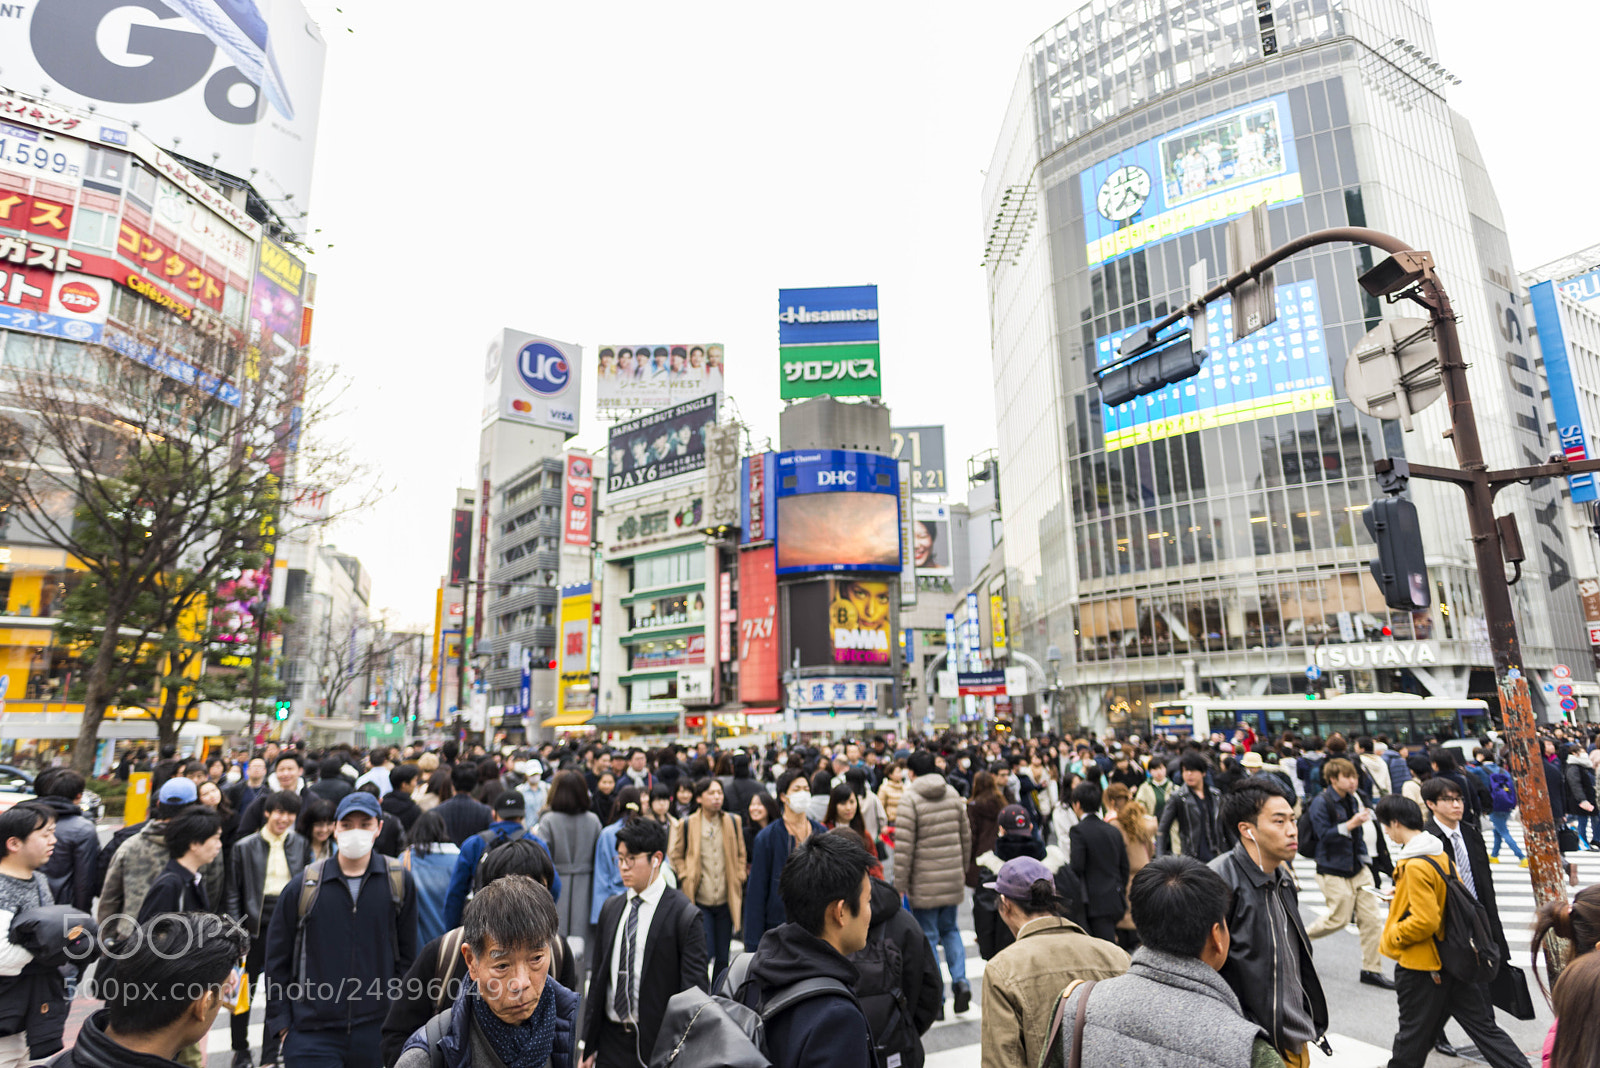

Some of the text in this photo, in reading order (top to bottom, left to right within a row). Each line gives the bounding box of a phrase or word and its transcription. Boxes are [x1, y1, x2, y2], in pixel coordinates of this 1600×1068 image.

[118, 223, 221, 300] コンタクト
[783, 358, 878, 382] サロンパス
[550, 409, 574, 421] VISA
[611, 420, 640, 438] JAPAN
[641, 408, 674, 428] DEBUT
[675, 396, 714, 416] SINGLE
[609, 464, 657, 491] DAY6
[817, 471, 856, 486] DHC
[834, 628, 889, 649] DMM
[835, 648, 888, 662] Bitcoin
[1315, 643, 1436, 668] TSUTAYA
